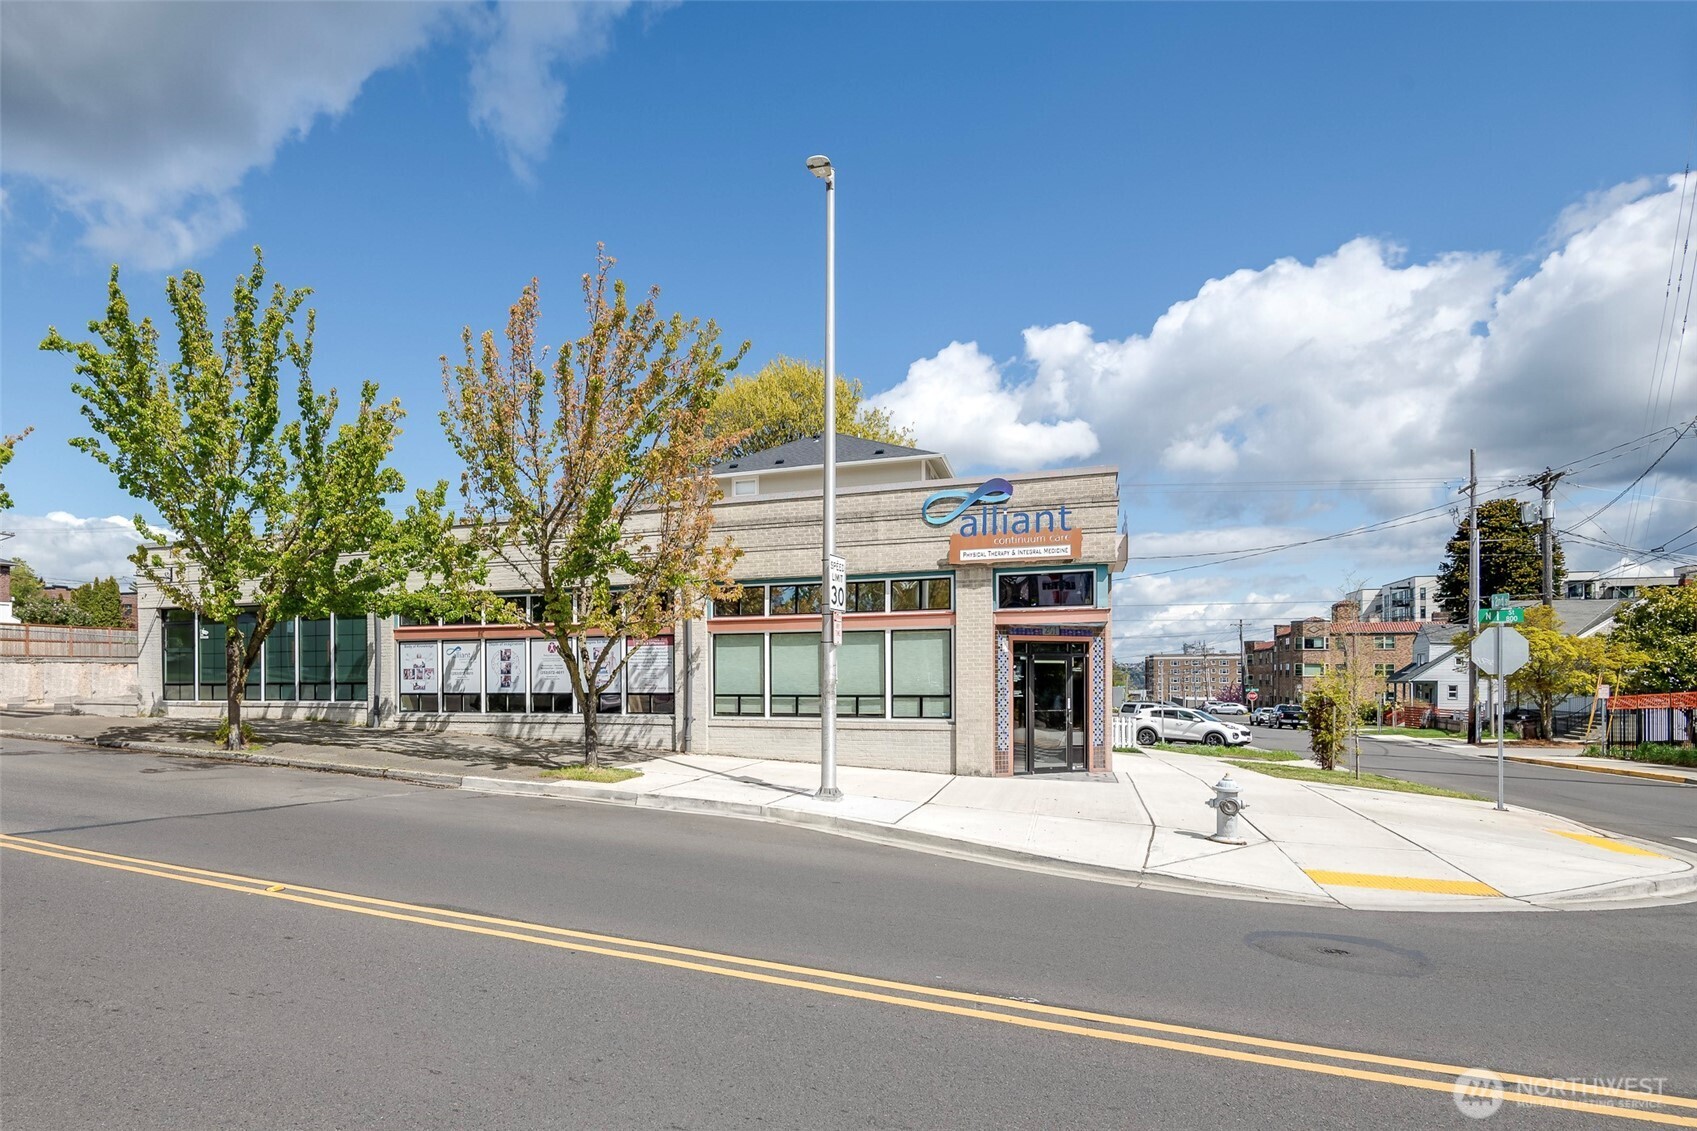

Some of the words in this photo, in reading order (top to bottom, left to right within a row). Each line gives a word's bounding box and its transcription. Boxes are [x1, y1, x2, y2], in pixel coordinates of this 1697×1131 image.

[960, 505, 1072, 537] alliant
[993, 535, 1046, 545] continuum
[1049, 534, 1070, 542] care
[962, 550, 987, 558] PHYSICAL
[987, 549, 1011, 557] THERAPY
[1011, 548, 1016, 556] &
[1017, 547, 1042, 556] INTEGRAL
[1043, 546, 1069, 554] MEDICINE
[830, 561, 844, 572] SPEED
[832, 574, 843, 583] LIMIT
[831, 585, 844, 606] 30
[1485, 612, 1491, 620] N
